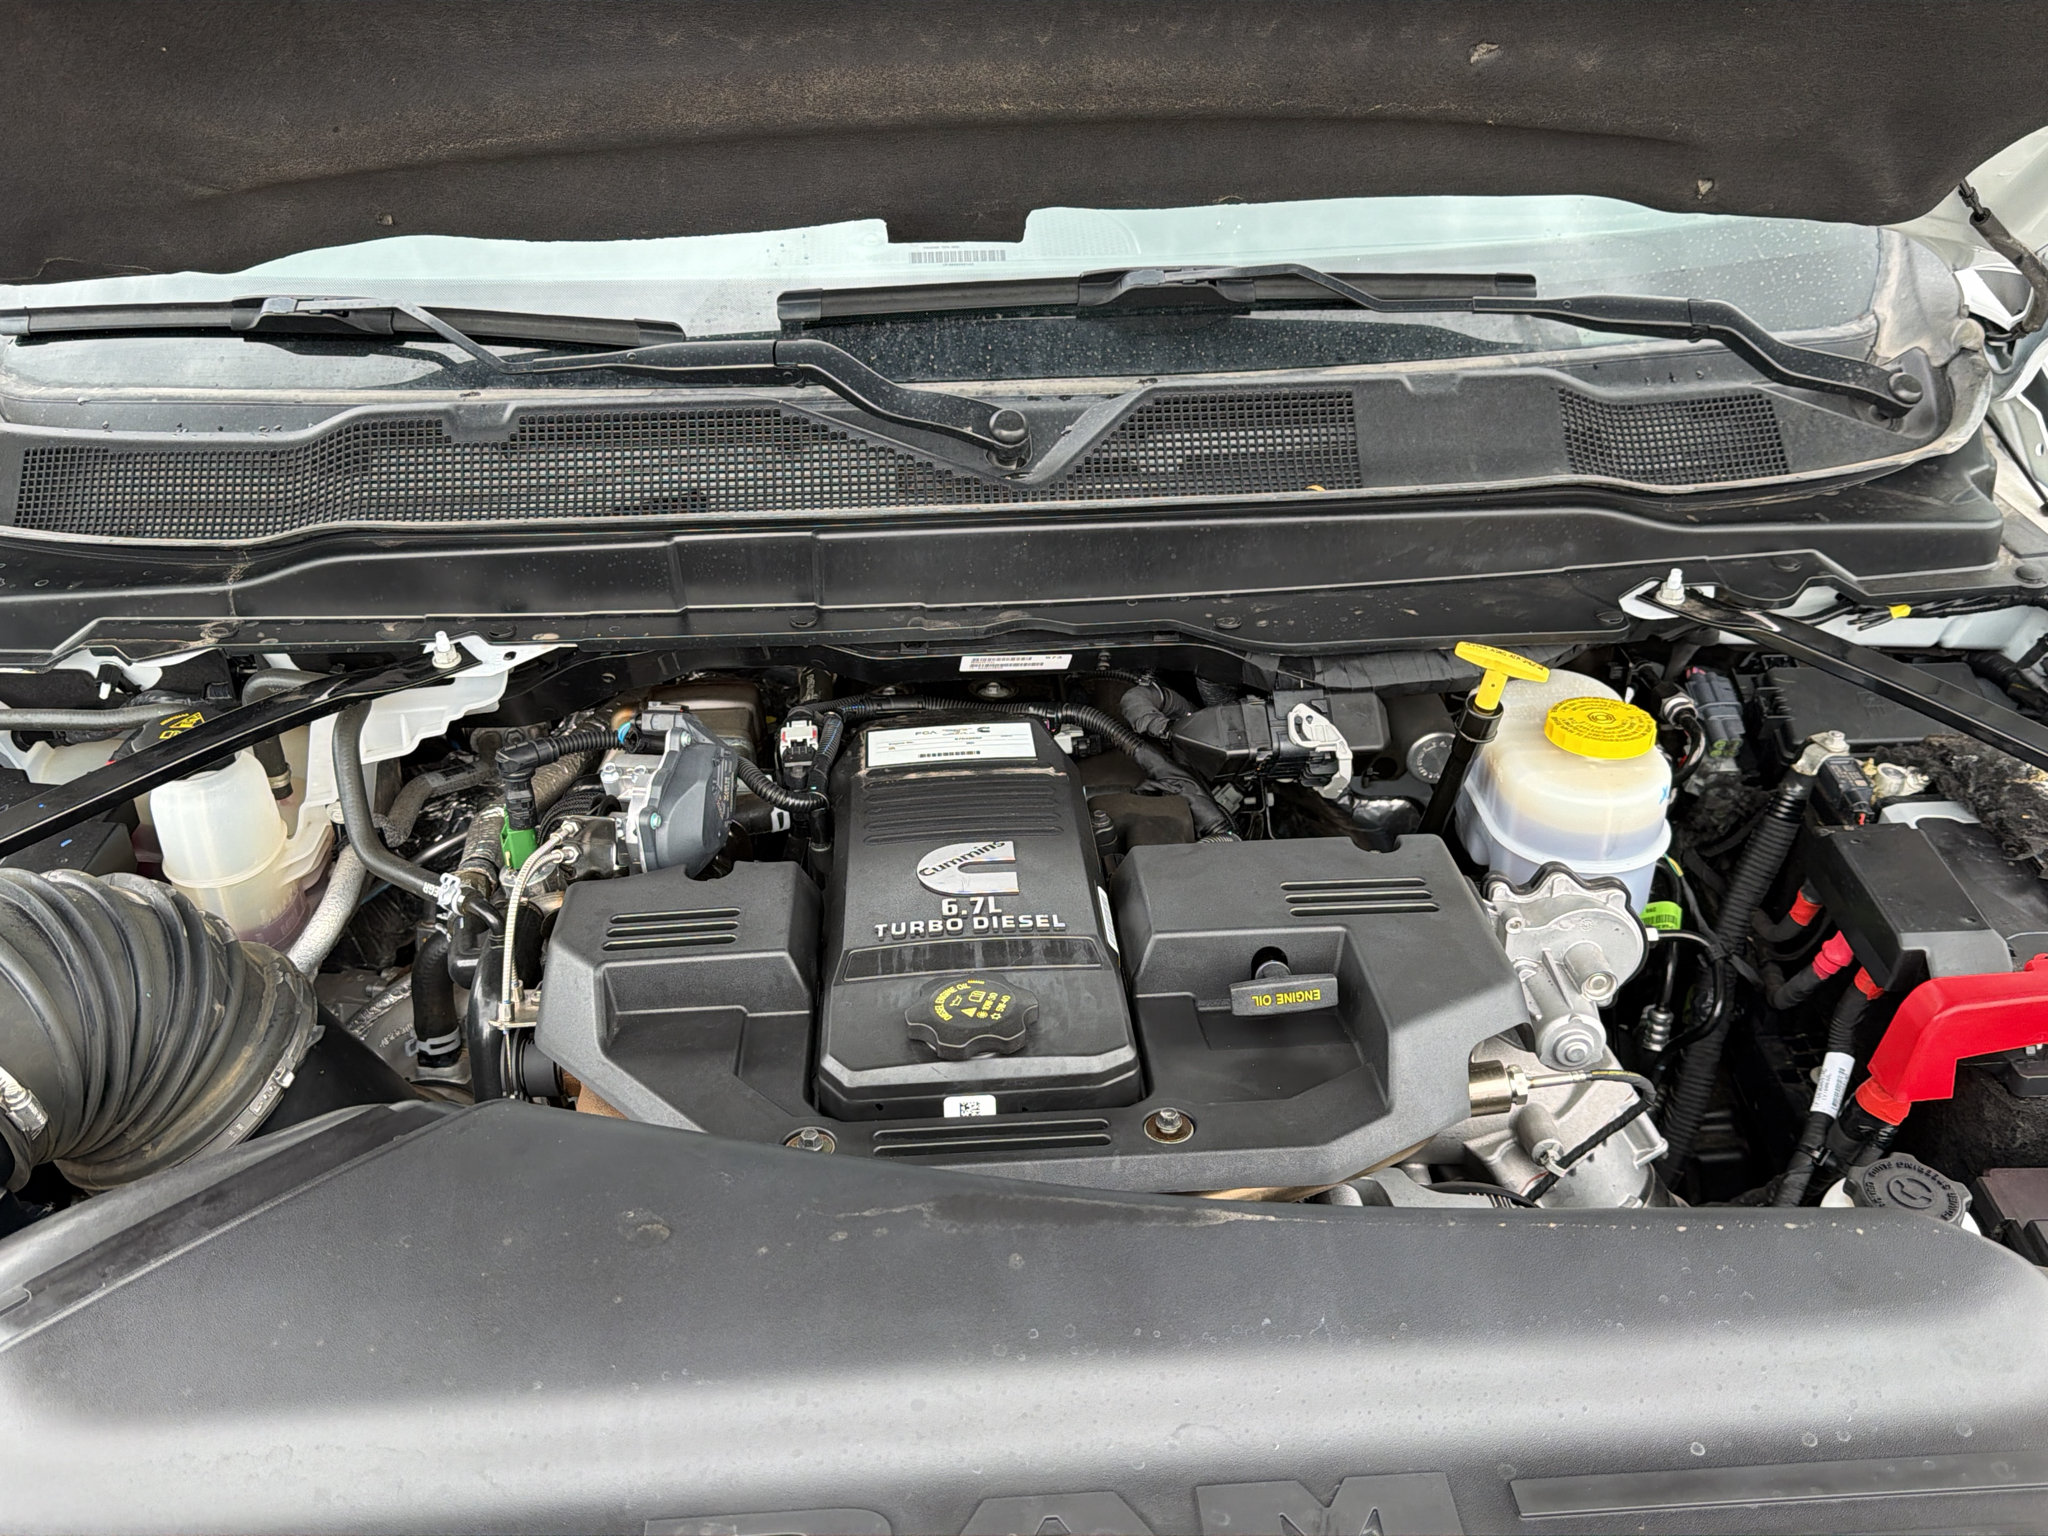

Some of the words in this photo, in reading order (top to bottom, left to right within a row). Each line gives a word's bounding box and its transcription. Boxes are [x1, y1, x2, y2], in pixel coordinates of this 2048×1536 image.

[918, 840, 1006, 877] Cummins
[941, 896, 1003, 917] 6.7L
[874, 917, 964, 940] TURBO
[972, 914, 1067, 934] DIESEL
[934, 985, 958, 1004] ENGINE
[956, 982, 972, 991] OIL
[995, 994, 1012, 1013] 5W-40
[1251, 994, 1272, 1007] OIL
[1275, 988, 1321, 1005] ENGINE
[934, 1003, 953, 1021] DIESEL
